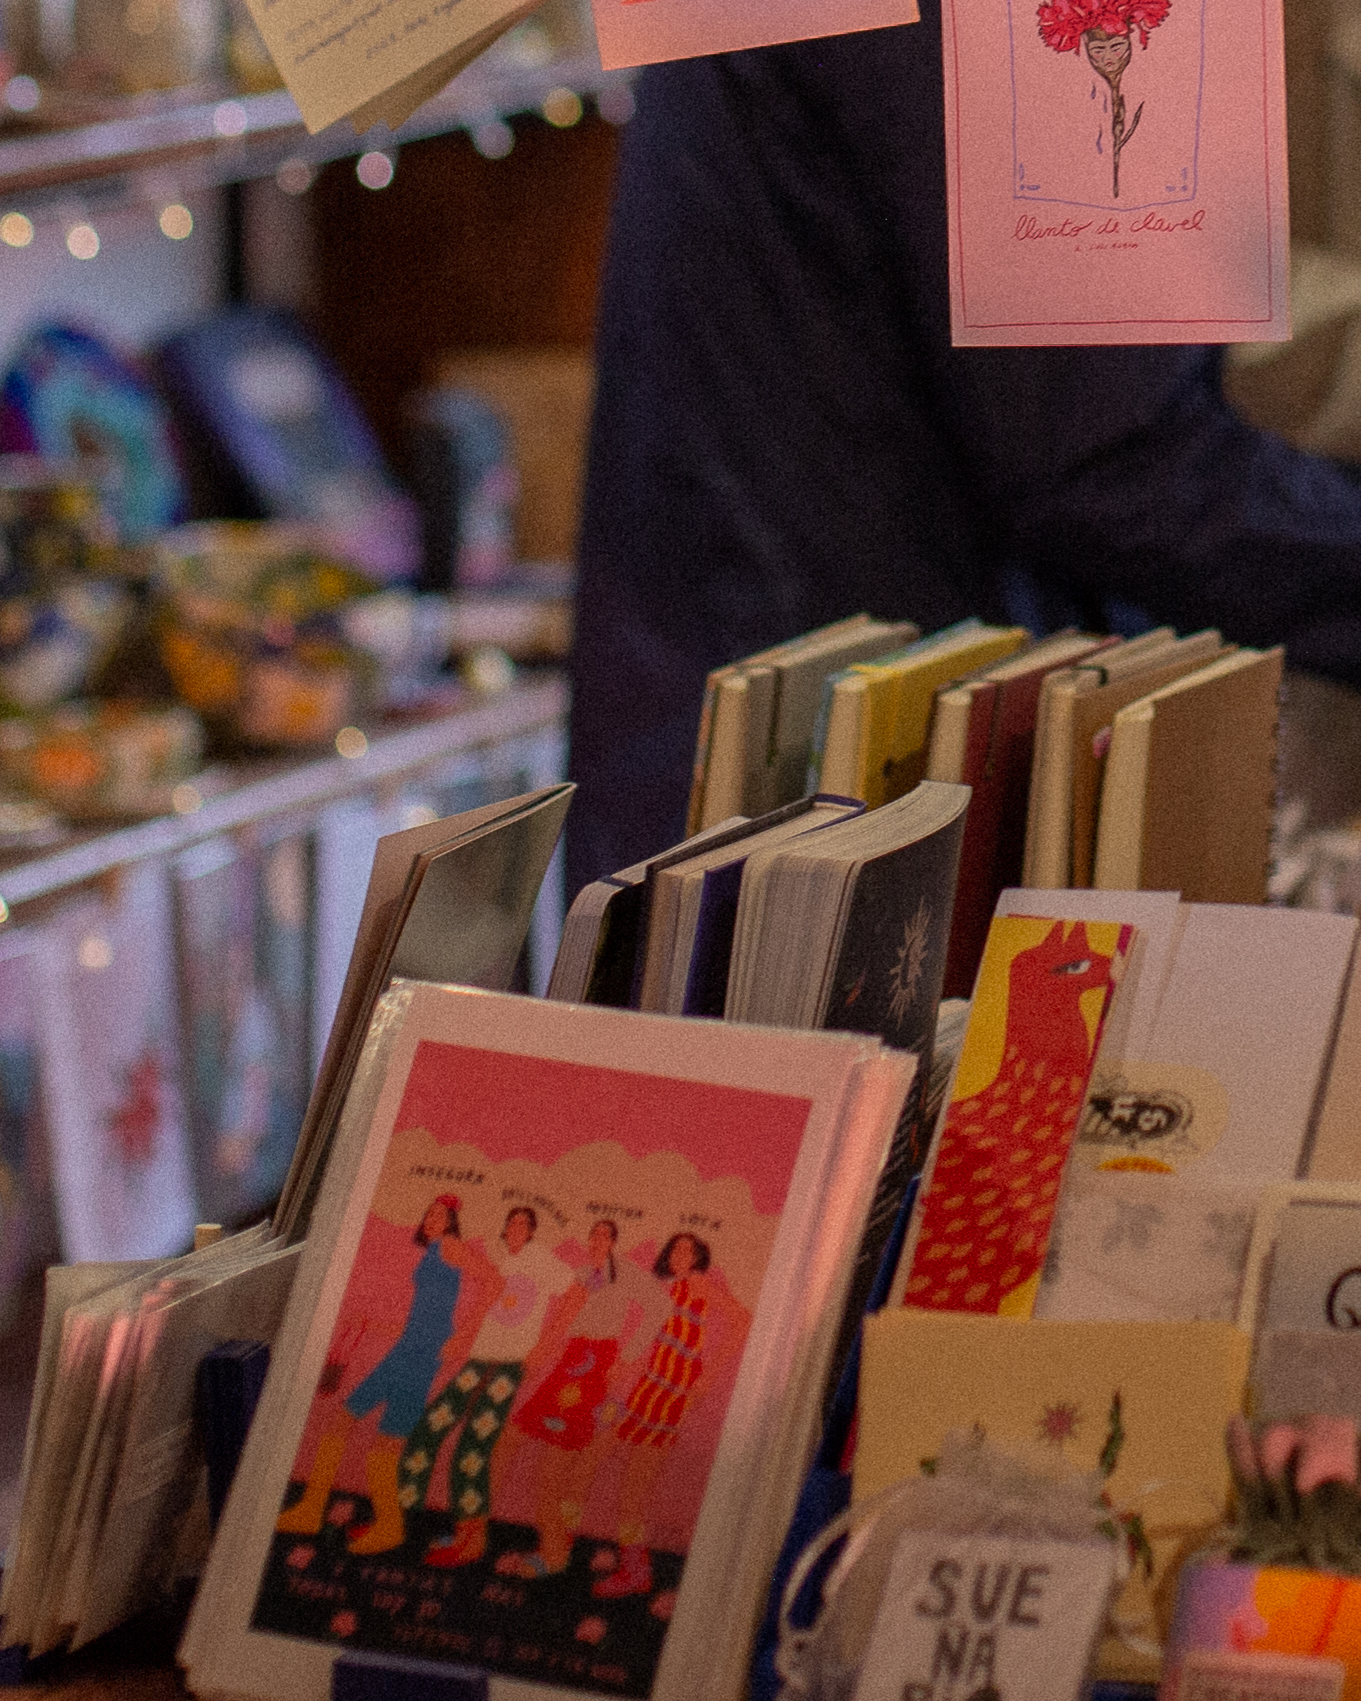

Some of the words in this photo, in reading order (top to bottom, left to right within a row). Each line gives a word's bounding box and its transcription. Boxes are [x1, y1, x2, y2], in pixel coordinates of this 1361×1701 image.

[1012, 213, 1093, 241] llanto
[1096, 217, 1120, 235] de
[1129, 209, 1206, 233] clavel
[914, 1557, 1052, 1629] SUE
